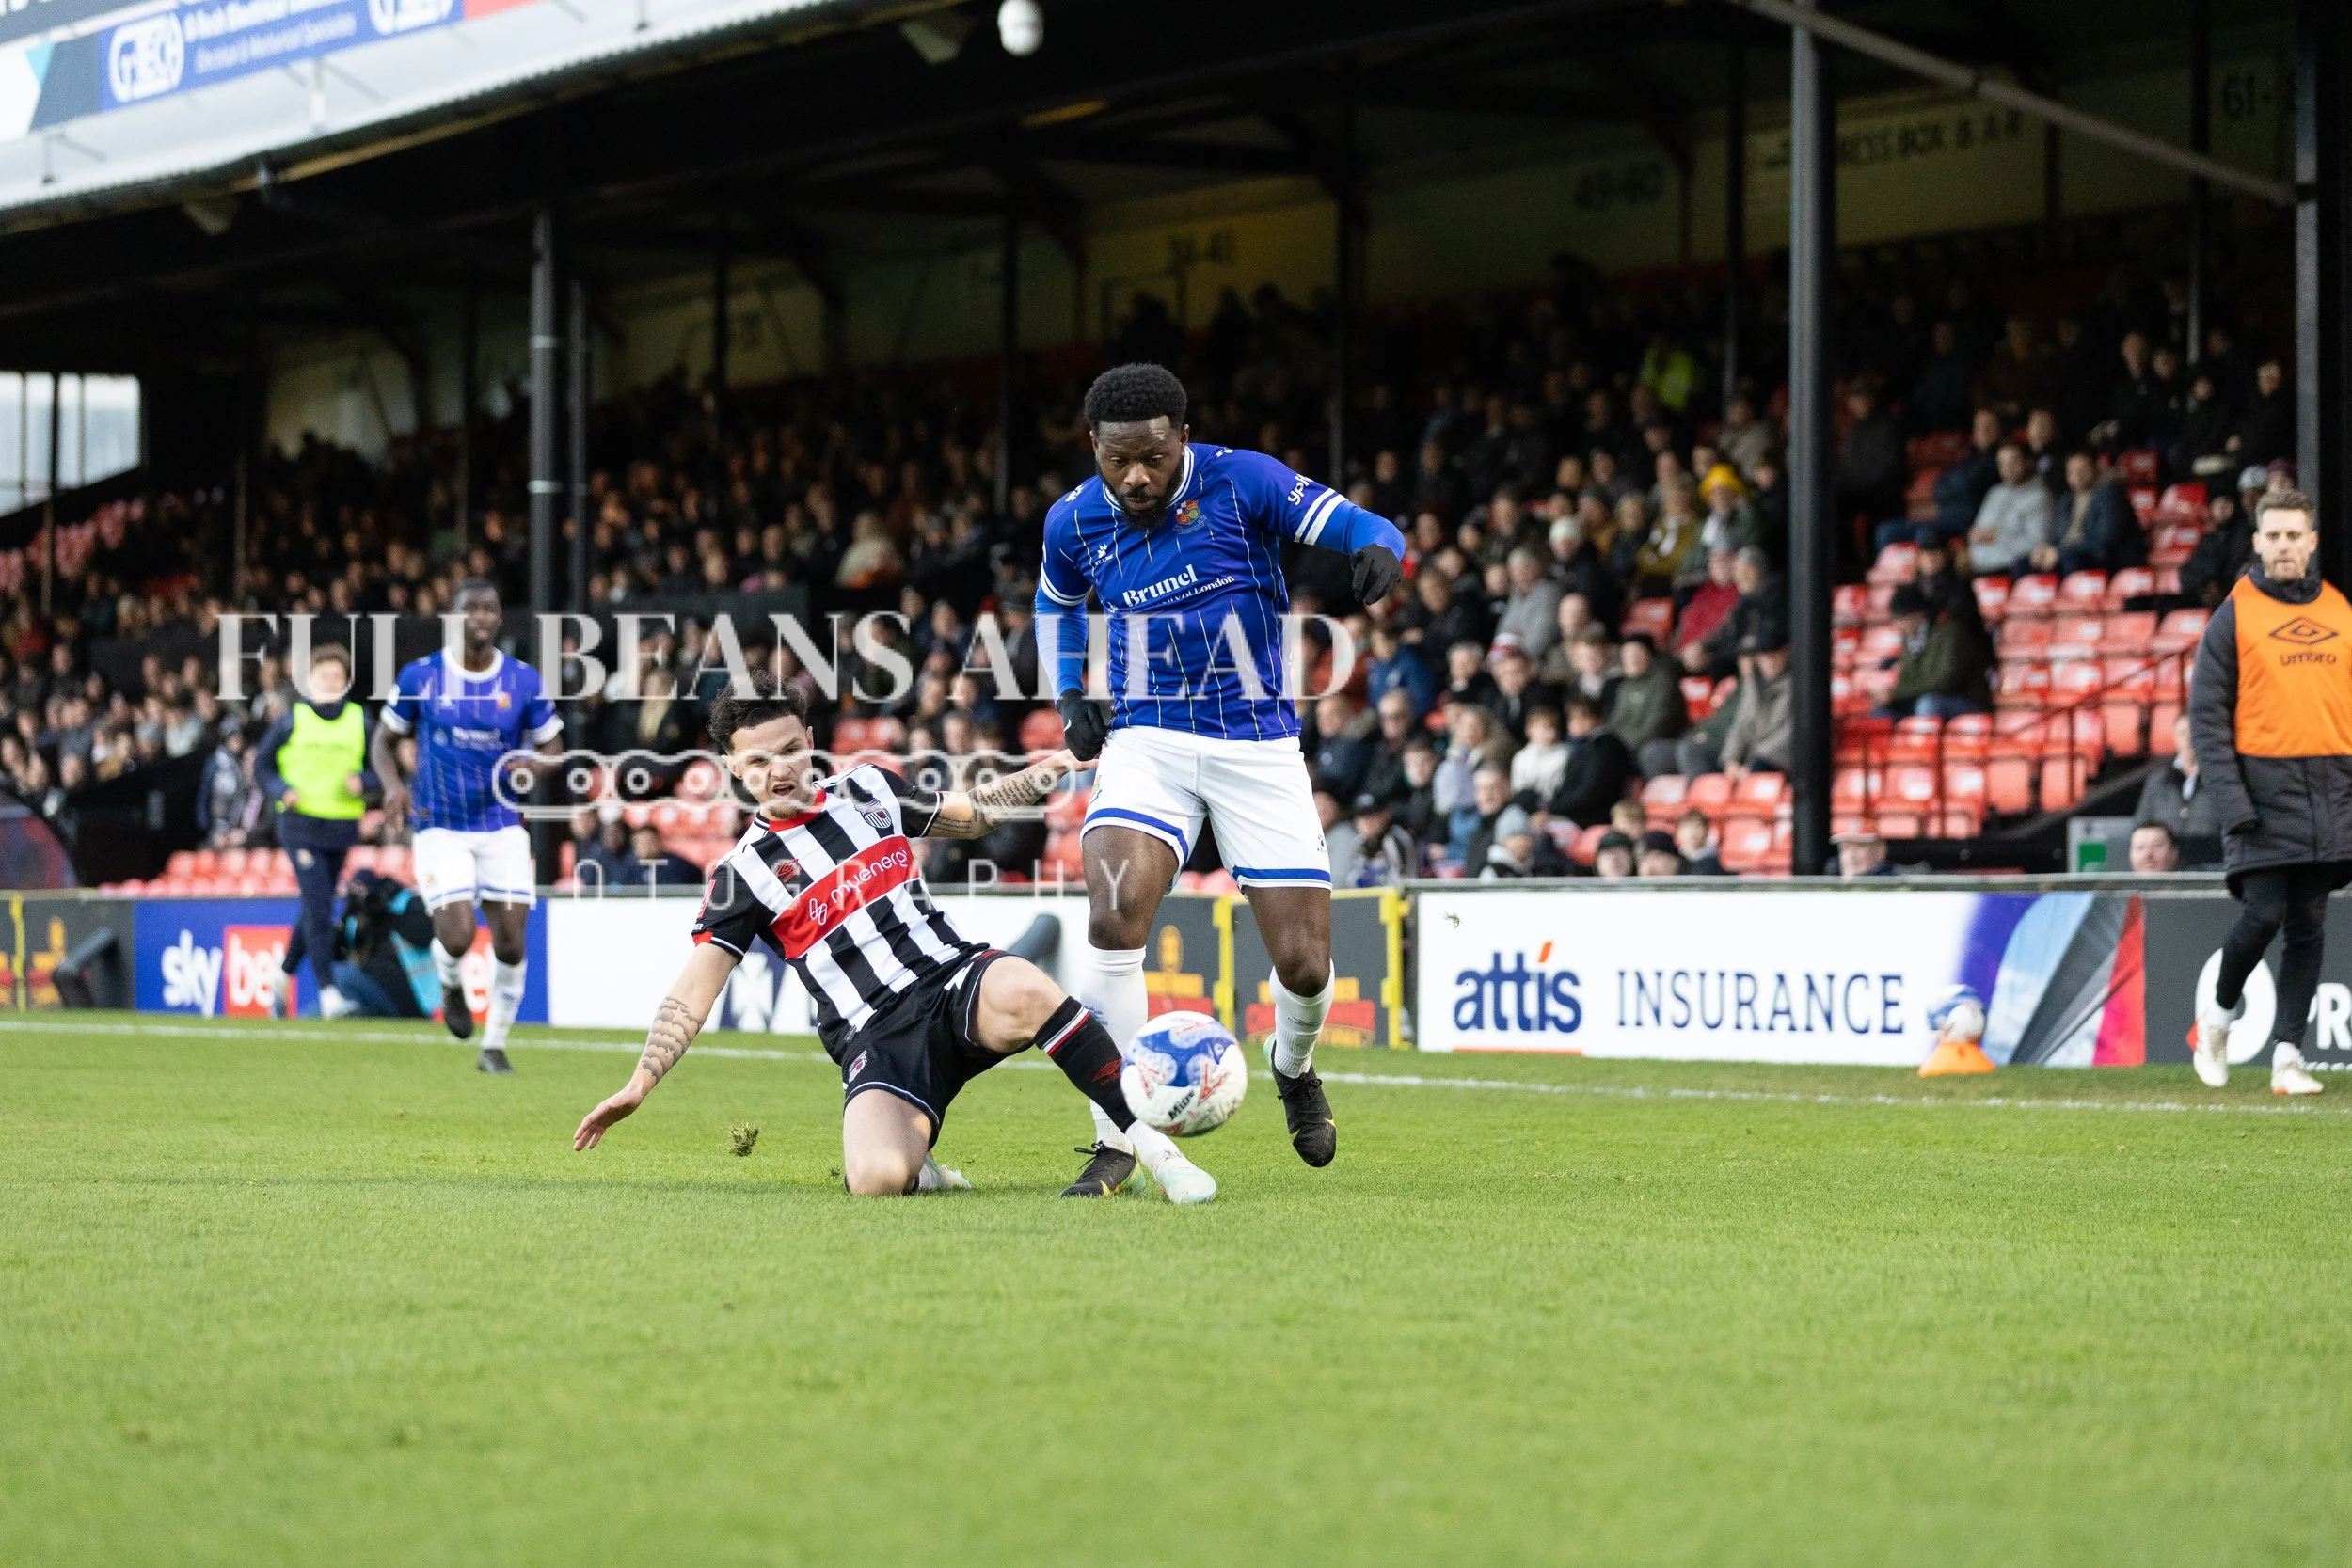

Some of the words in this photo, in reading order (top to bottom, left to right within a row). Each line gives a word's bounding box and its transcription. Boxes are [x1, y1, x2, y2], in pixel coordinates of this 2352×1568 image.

[1122, 564, 1199, 608] Brunel
[1194, 575, 1235, 594] London
[830, 847, 909, 904] myenergi
[161, 928, 223, 1019] sky
[1454, 941, 1582, 1034] attis
[1617, 970, 1904, 1035] INSURANCE
